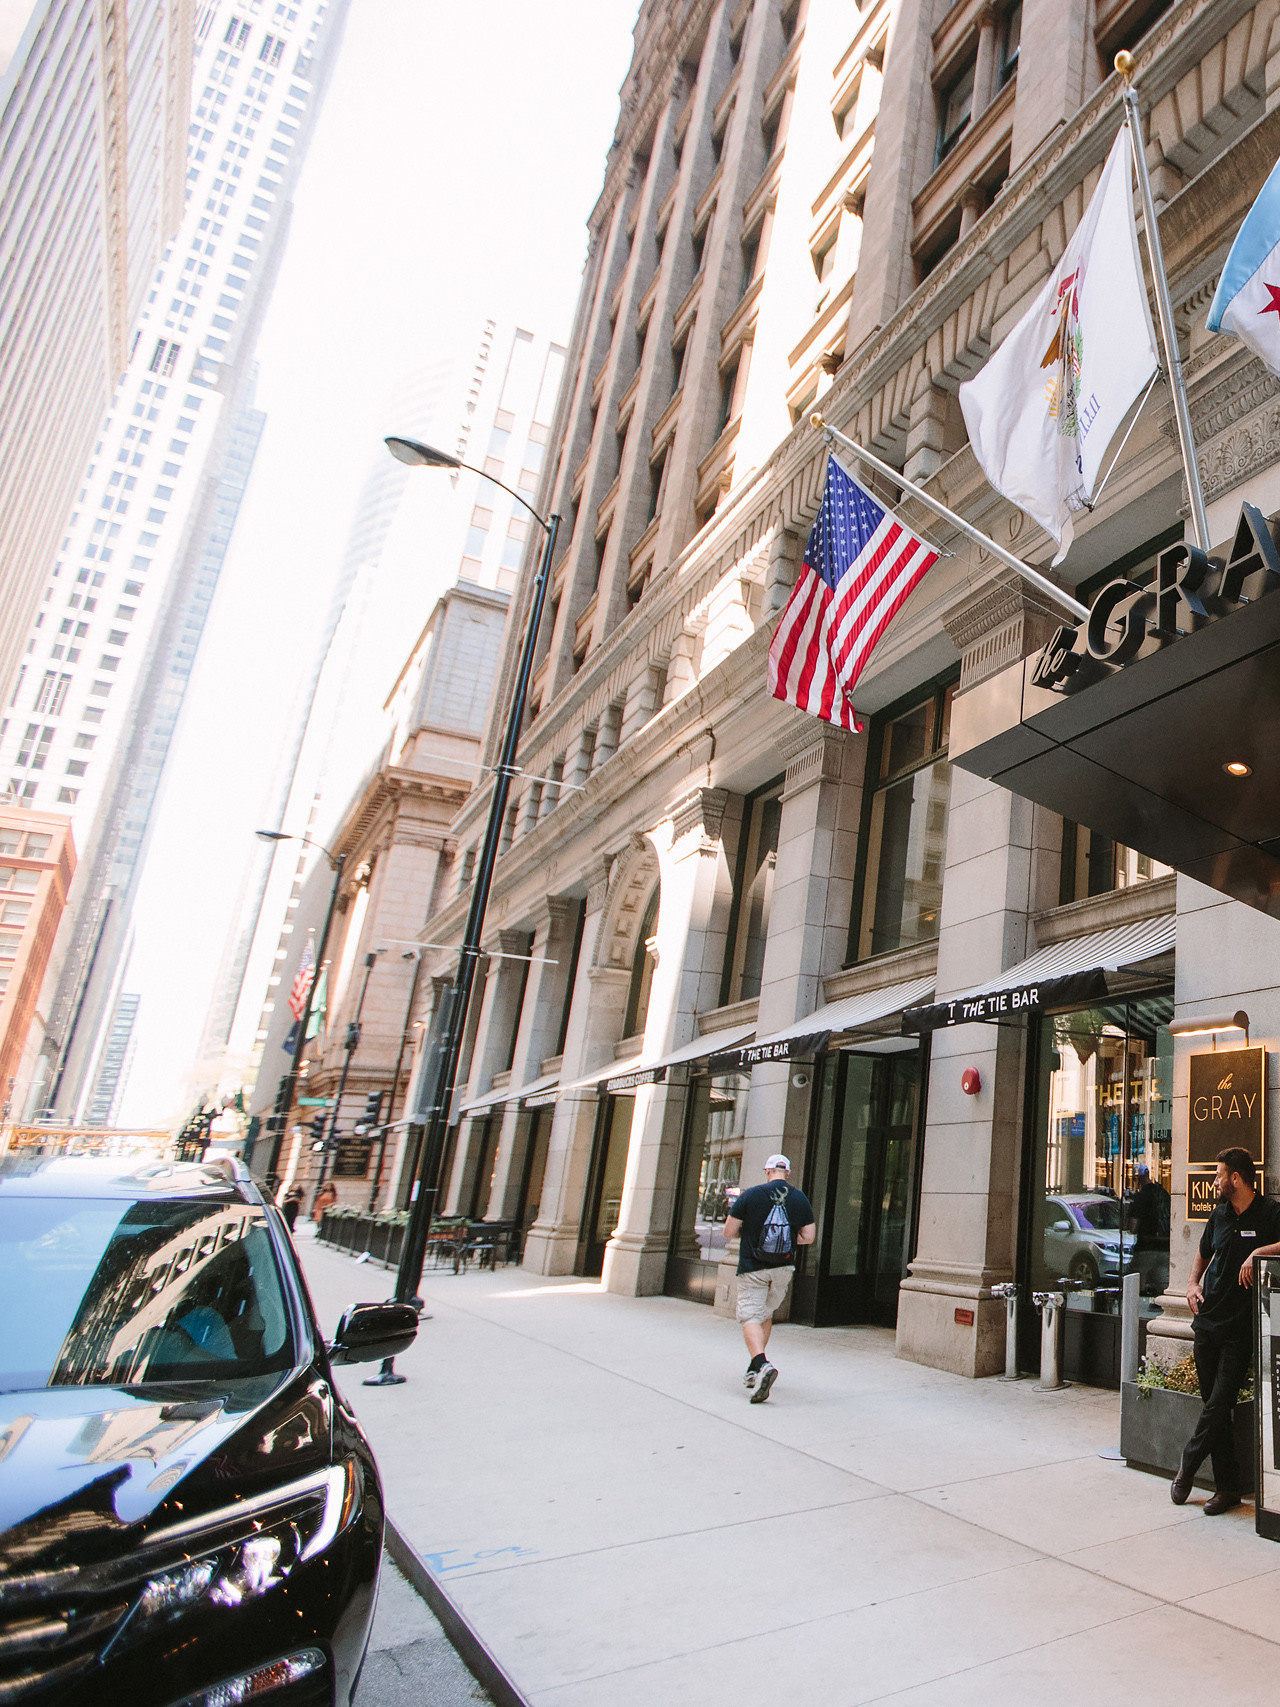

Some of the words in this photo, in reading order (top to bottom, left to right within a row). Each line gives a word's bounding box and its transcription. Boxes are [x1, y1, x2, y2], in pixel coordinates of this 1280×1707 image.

[1030, 626, 1078, 690] the
[962, 998, 985, 1018] THE
[987, 994, 1008, 1013] TIE
[1011, 988, 1039, 1008] BAR
[747, 1048, 761, 1061] THE
[761, 1046, 772, 1059] TIE
[773, 1043, 789, 1057] BAR
[607, 1075, 635, 1091] STARBUCKS
[635, 1070, 655, 1085] COFFEE
[1086, 1083, 1124, 1106] THE
[1130, 1079, 1162, 1101] TIE
[1217, 1073, 1233, 1090] the
[1193, 1093, 1256, 1122] GRAY
[1191, 1201, 1212, 1212] hotels
